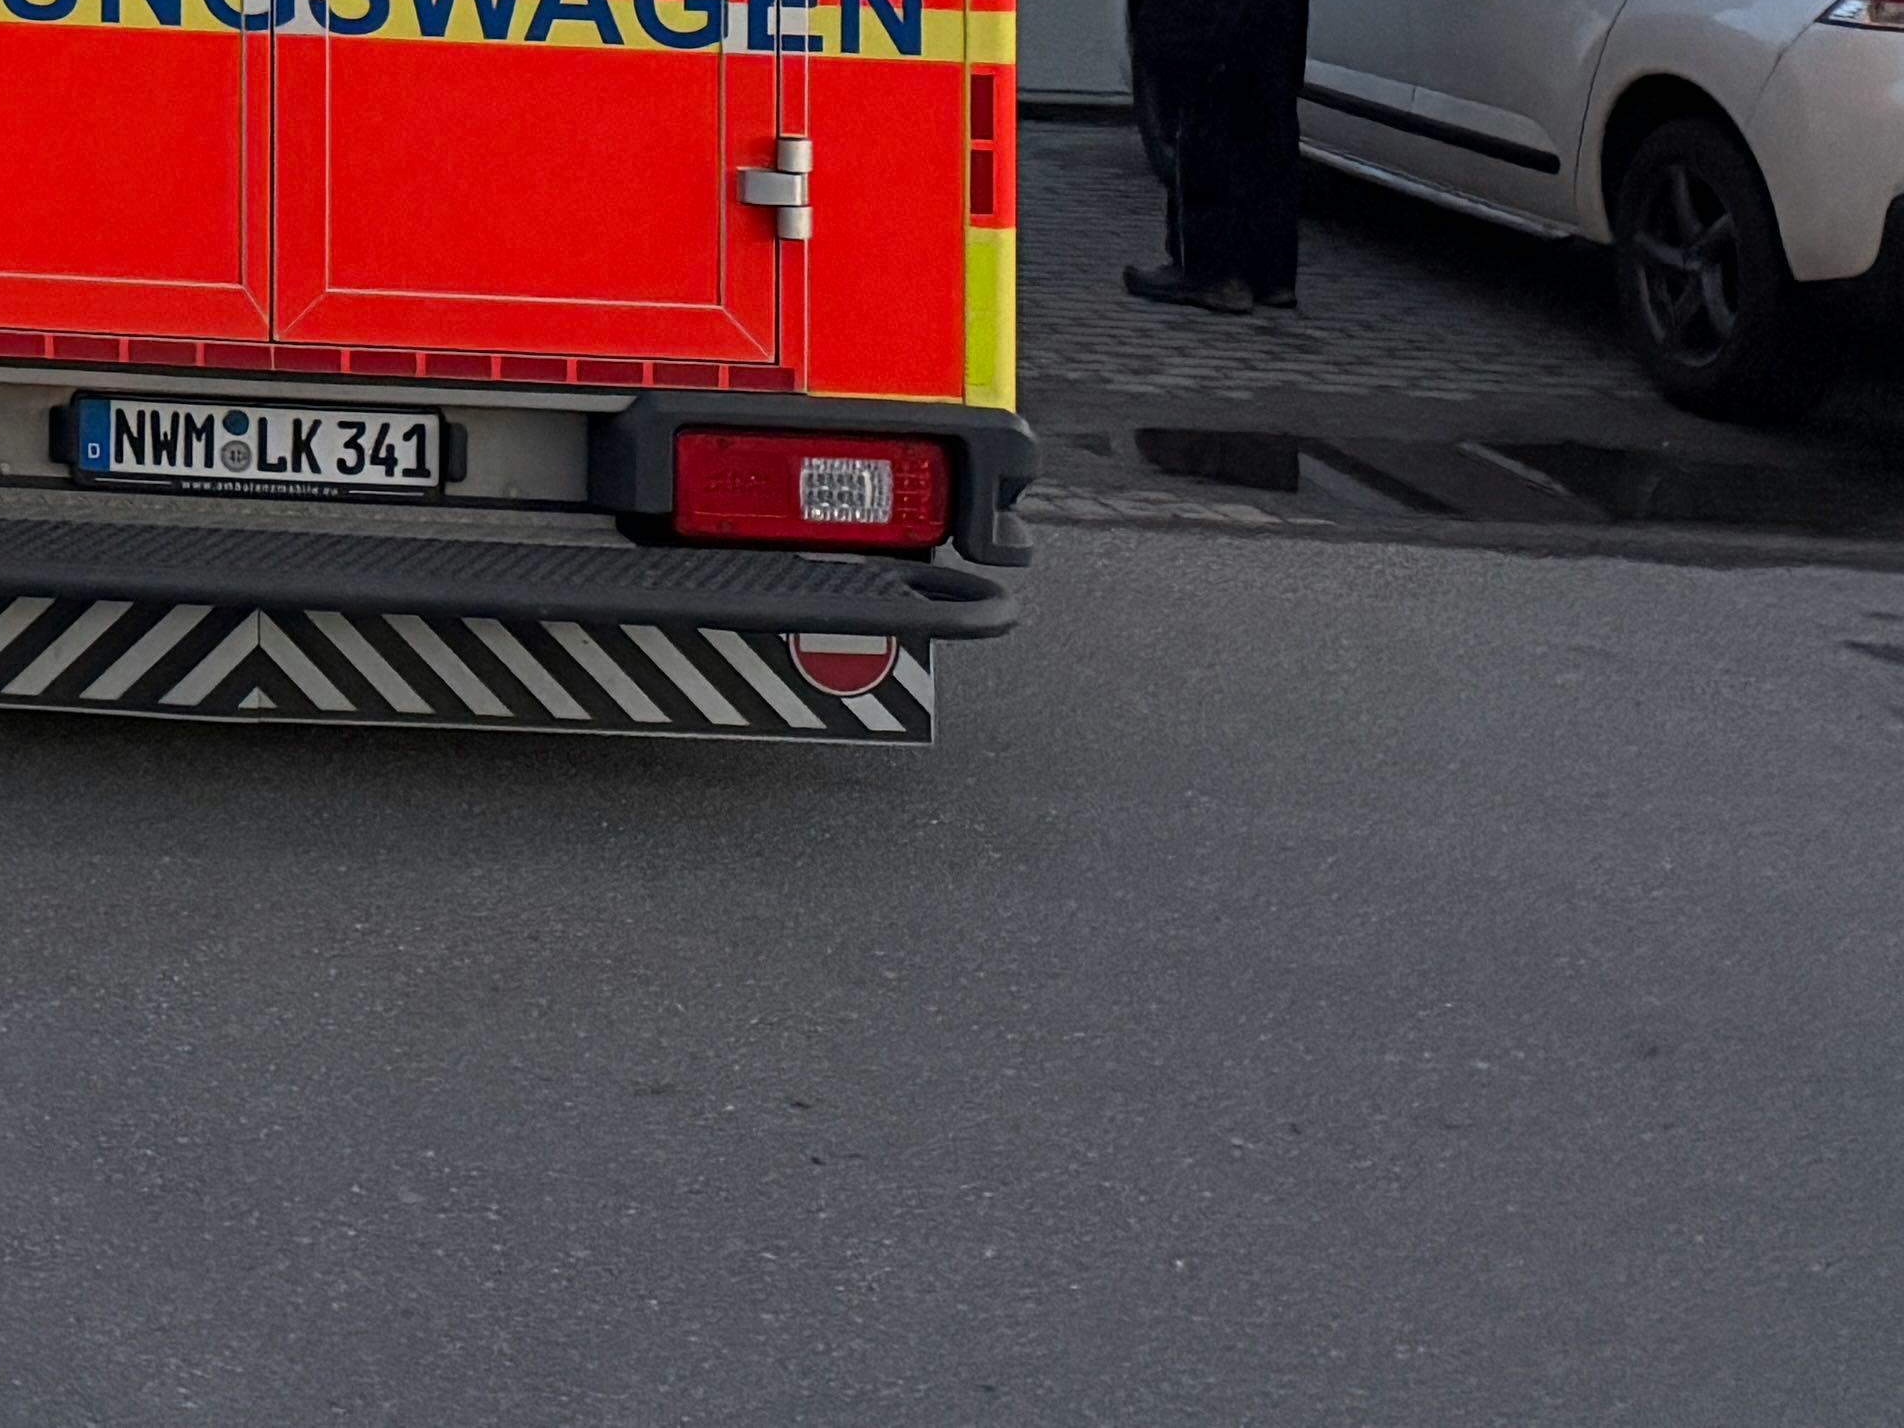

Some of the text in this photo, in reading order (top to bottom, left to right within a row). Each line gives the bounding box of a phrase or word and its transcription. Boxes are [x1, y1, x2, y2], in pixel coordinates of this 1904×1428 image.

[87, 407, 432, 479] D NWM LK 341
